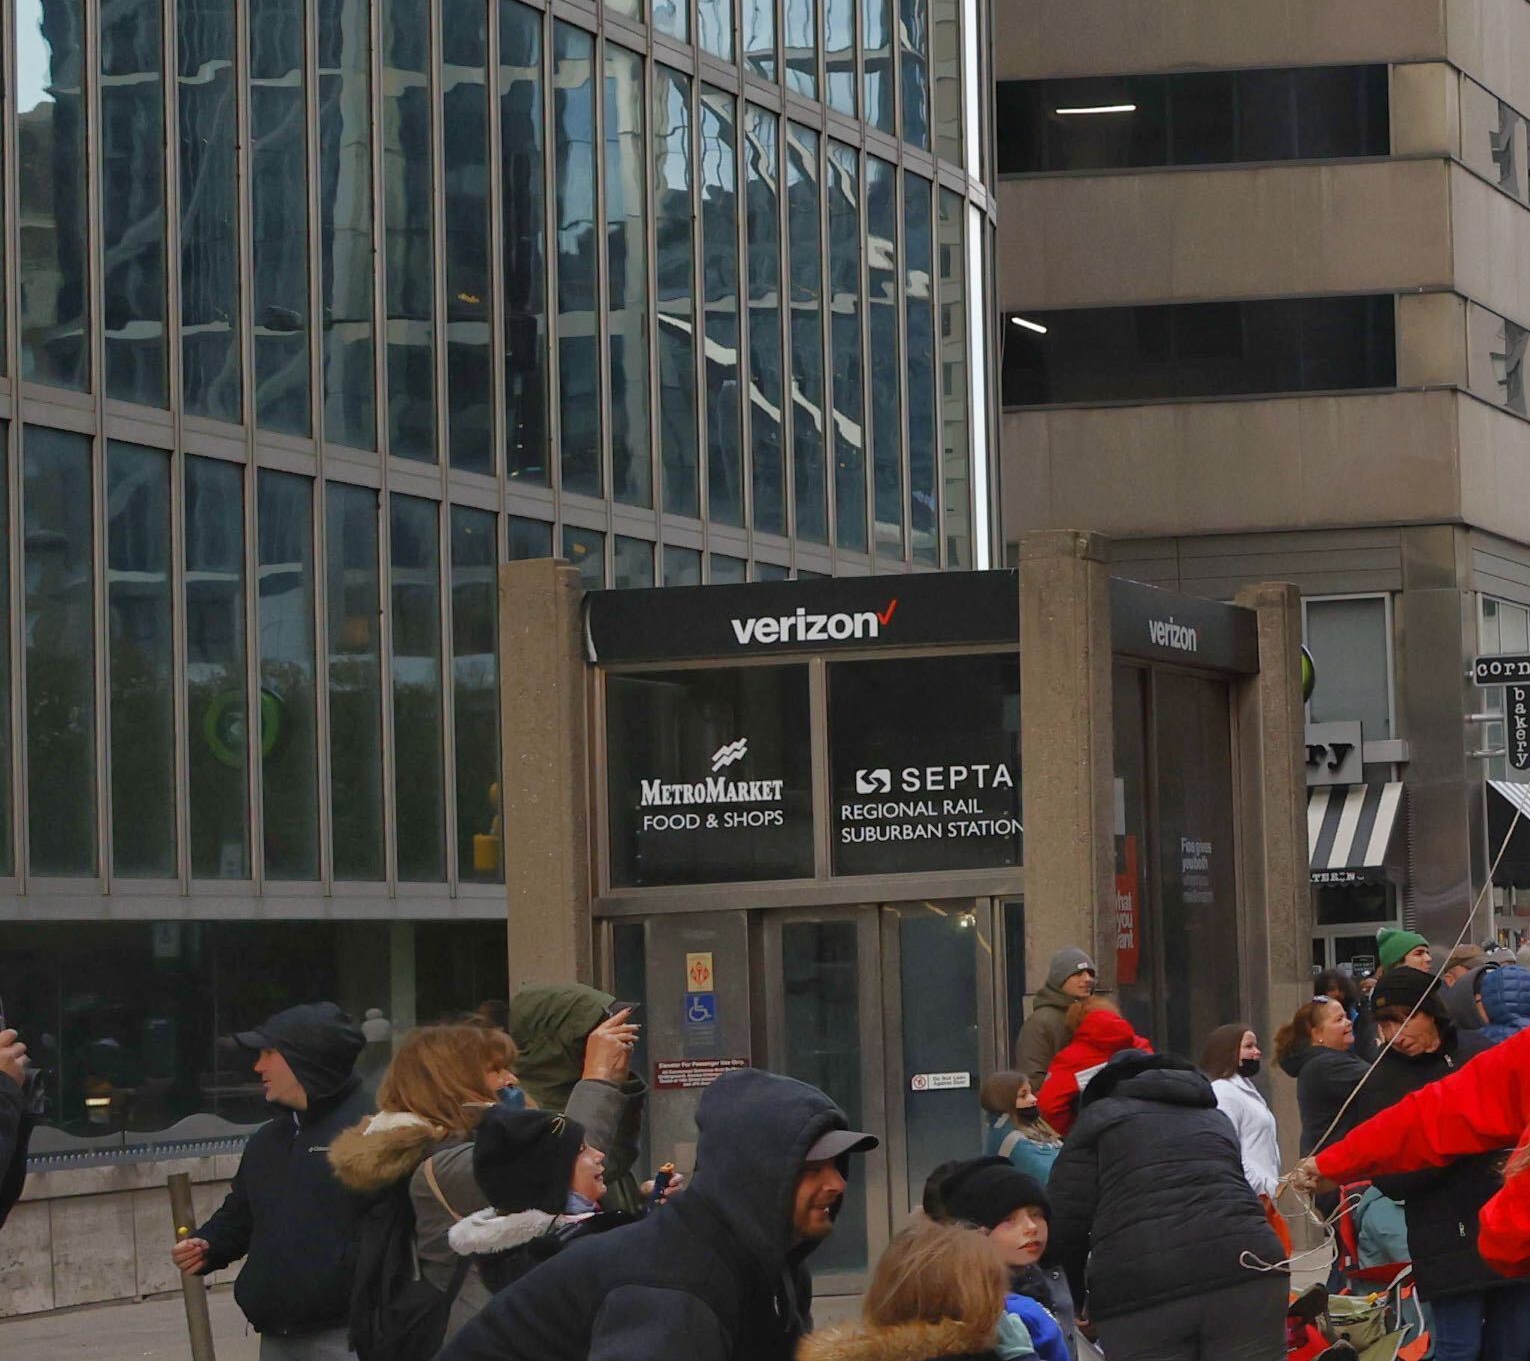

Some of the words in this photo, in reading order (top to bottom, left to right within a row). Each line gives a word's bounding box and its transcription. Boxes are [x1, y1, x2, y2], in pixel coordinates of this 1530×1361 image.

[731, 607, 879, 645] verizon
[1149, 616, 1197, 652] verizon
[1513, 687, 1530, 768] bakery
[901, 763, 1013, 792] SEPTA
[643, 813, 701, 831] FOOD
[705, 813, 719, 828] &
[724, 810, 784, 828] SHOPS
[841, 800, 938, 821] REGIONAL
[943, 798, 984, 815] RAIL
[841, 822, 942, 843] SUBURBAN
[947, 819, 1024, 838] STATION
